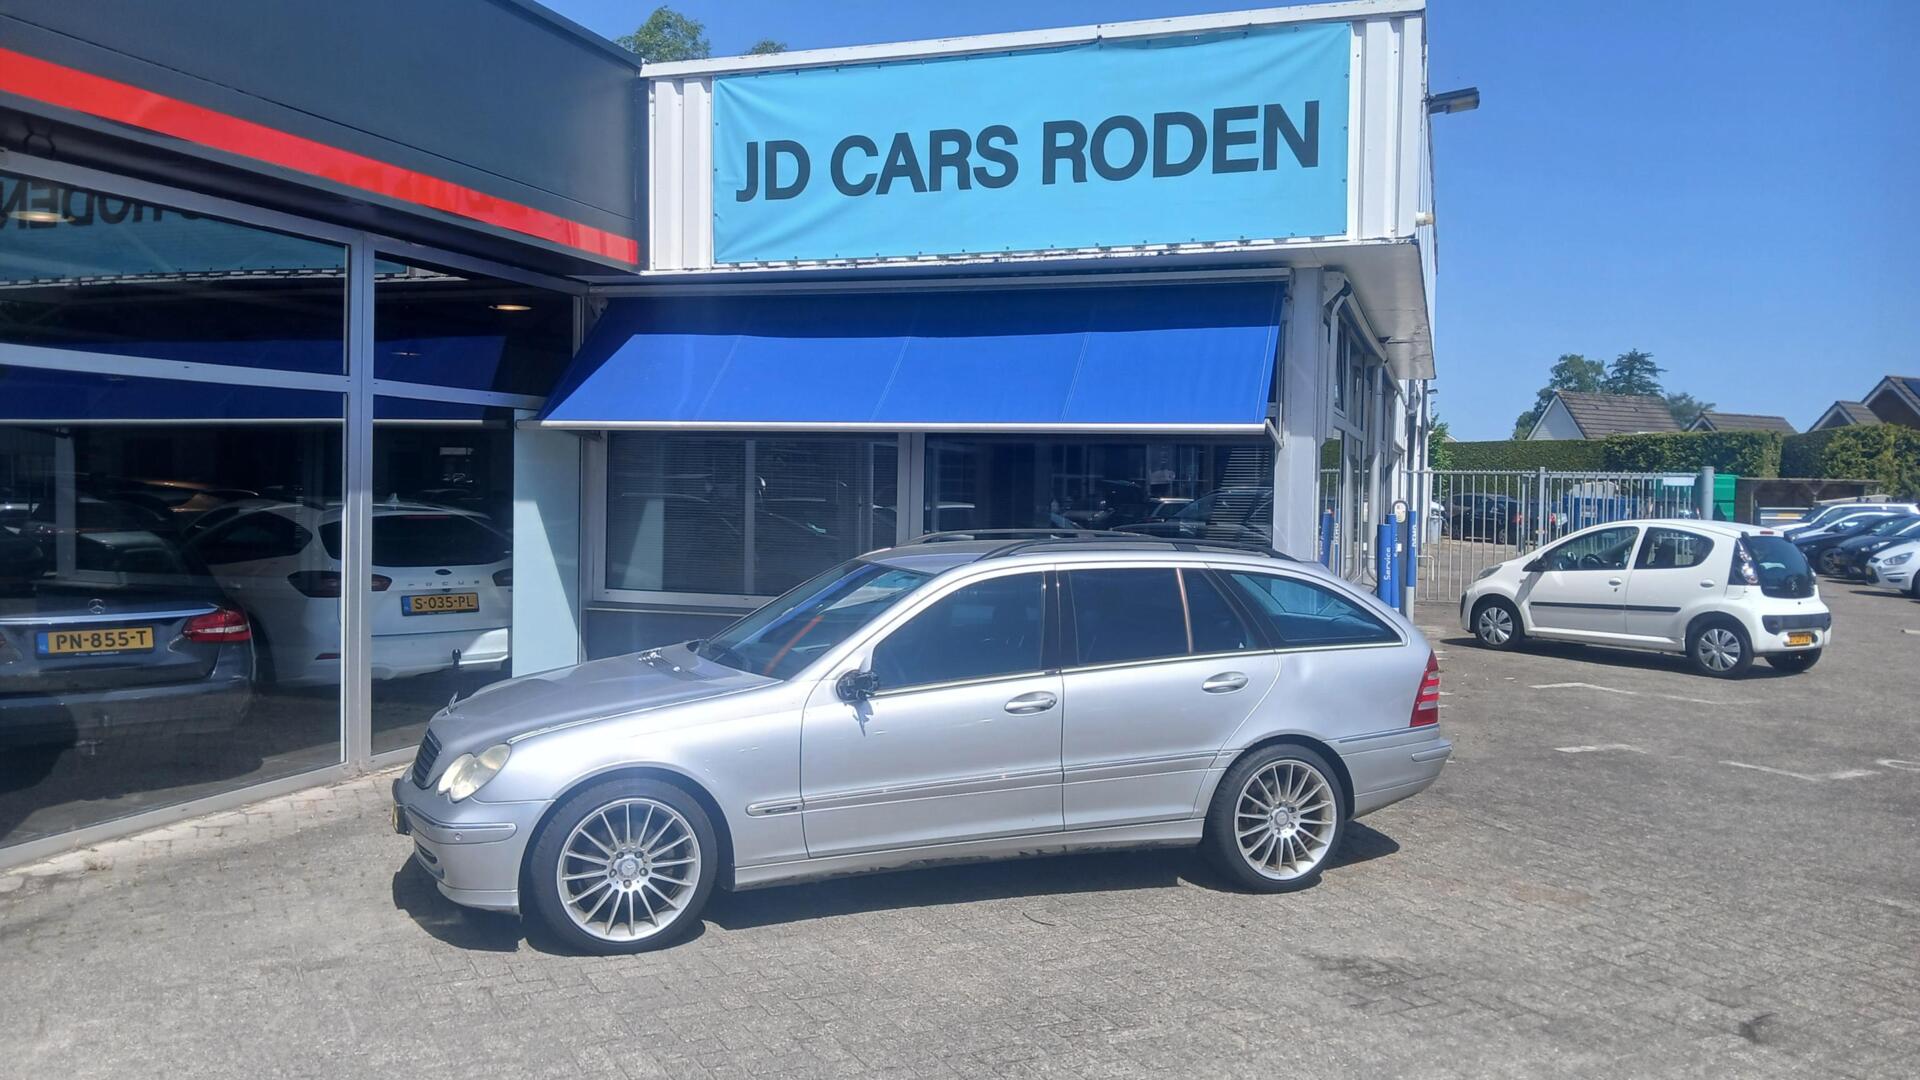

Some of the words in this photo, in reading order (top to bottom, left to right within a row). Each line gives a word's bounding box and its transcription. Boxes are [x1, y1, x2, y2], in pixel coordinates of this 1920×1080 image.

[736, 141, 811, 203] JD
[830, 125, 1019, 195] CARS
[1042, 100, 1320, 186] RODEN
[414, 596, 474, 610] S-035-PL
[56, 630, 147, 650] PN-855-T
